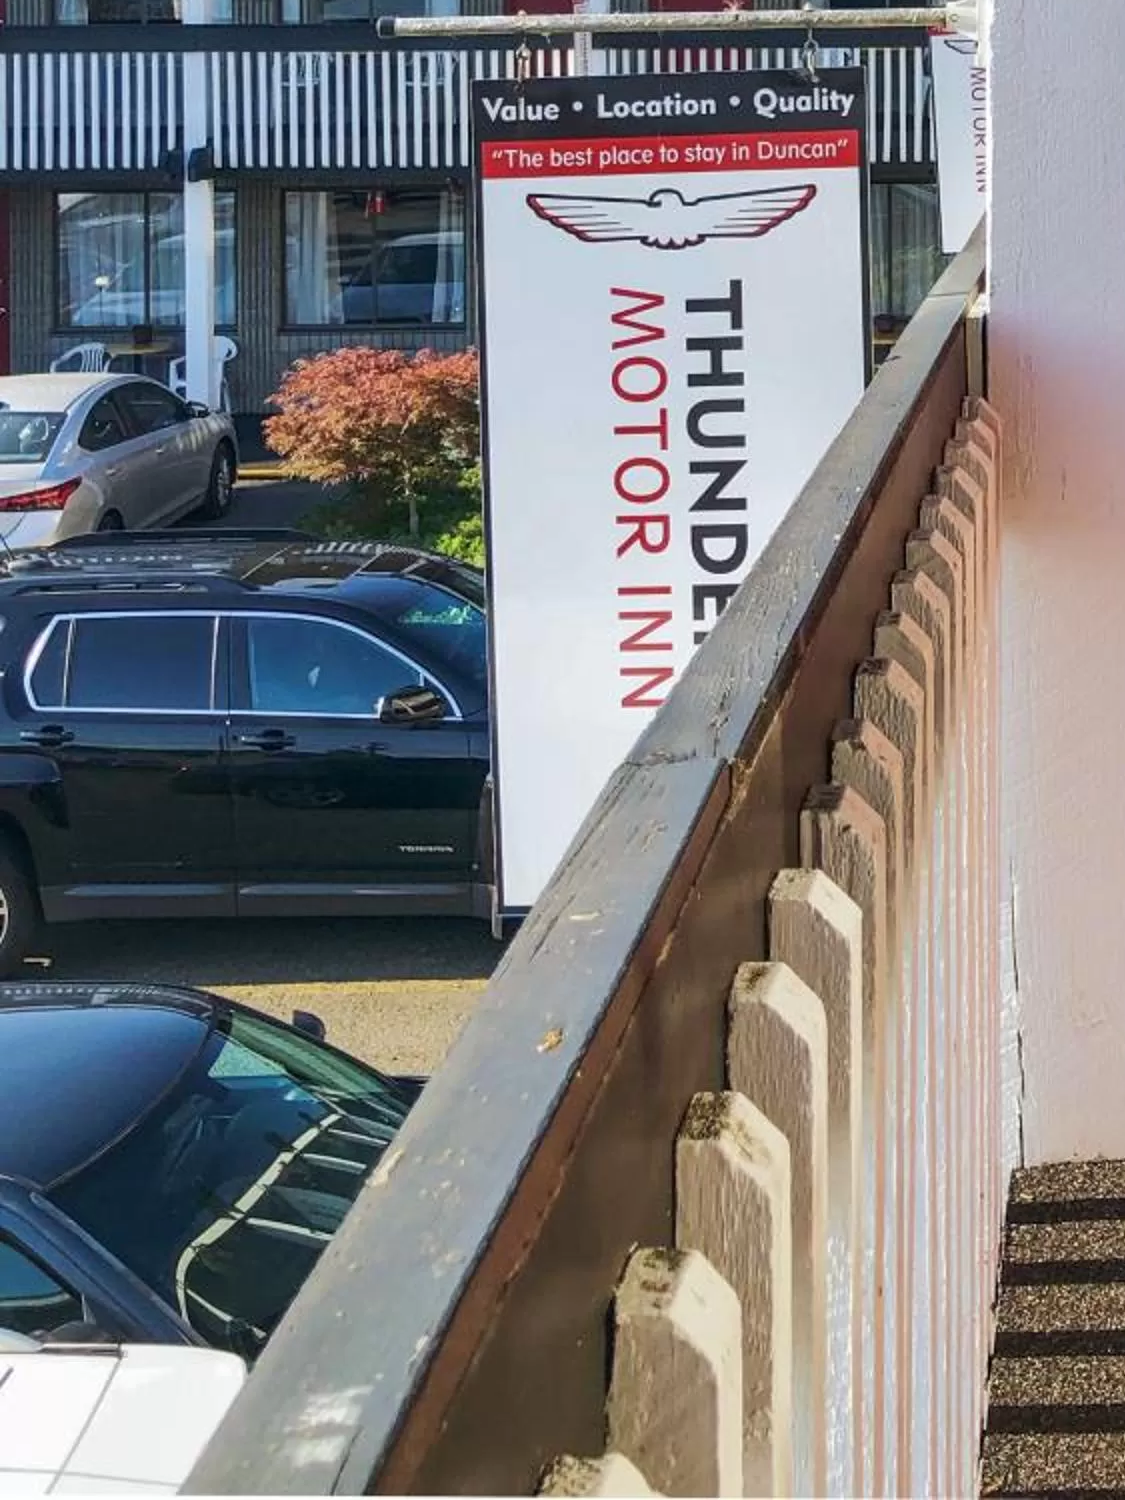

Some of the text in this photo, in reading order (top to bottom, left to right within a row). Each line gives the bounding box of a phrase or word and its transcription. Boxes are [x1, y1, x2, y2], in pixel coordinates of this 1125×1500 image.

[482, 87, 855, 122] Value Location Quality
[550, 147, 593, 166] best
[599, 145, 654, 170] place
[659, 144, 679, 164] to
[684, 143, 726, 165] stay
[732, 142, 750, 161] in
[610, 287, 675, 708] MOTOR INN
[685, 279, 748, 645] THUNDE
